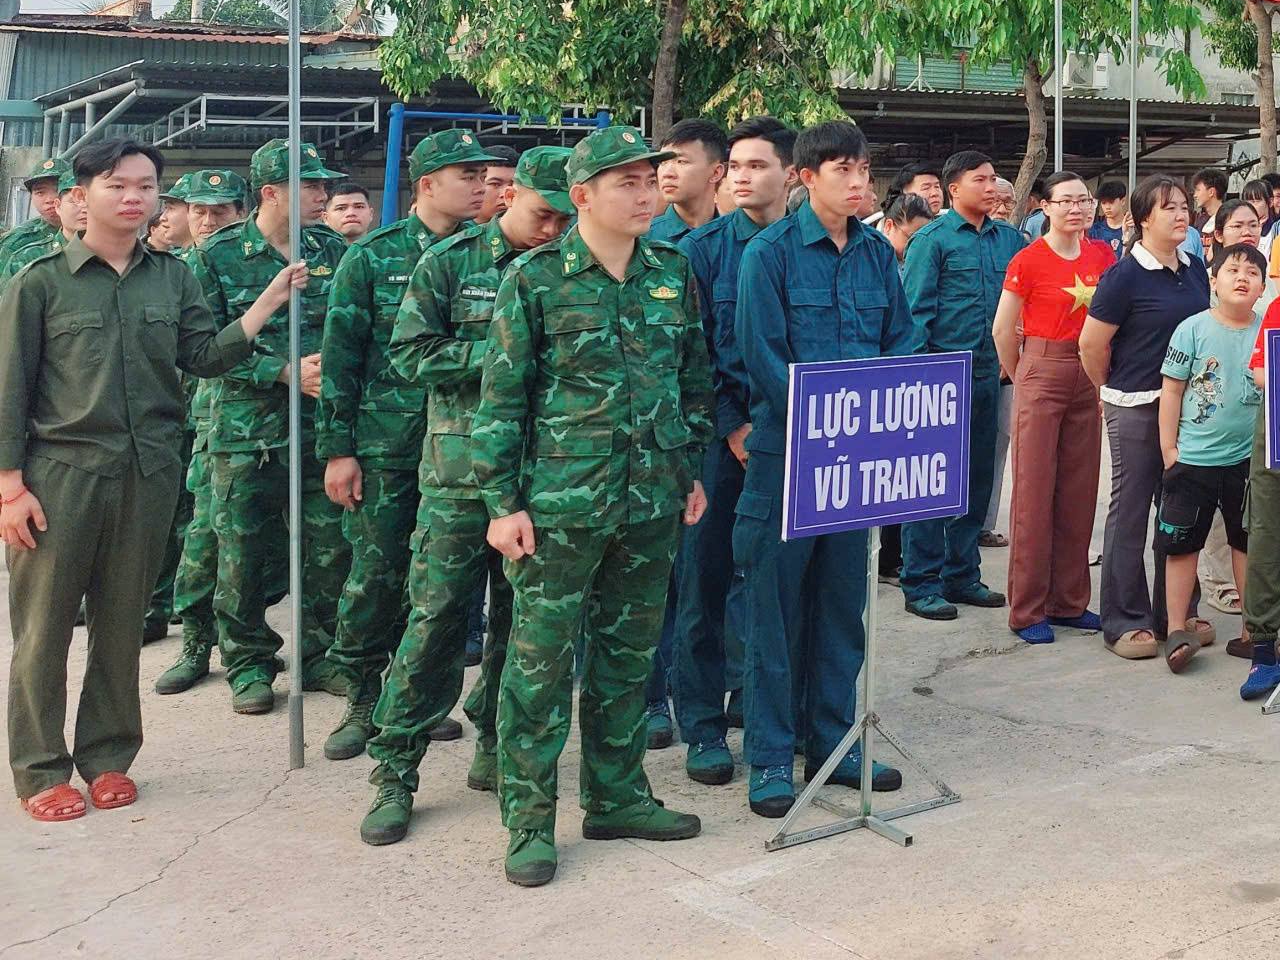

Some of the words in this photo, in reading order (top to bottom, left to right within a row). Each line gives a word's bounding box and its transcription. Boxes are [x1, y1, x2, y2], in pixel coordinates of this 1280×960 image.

[807, 387, 860, 448] LỰC
[870, 381, 956, 439] LƯỢNG
[814, 455, 850, 512] VŨ
[860, 452, 946, 506] TRANG
